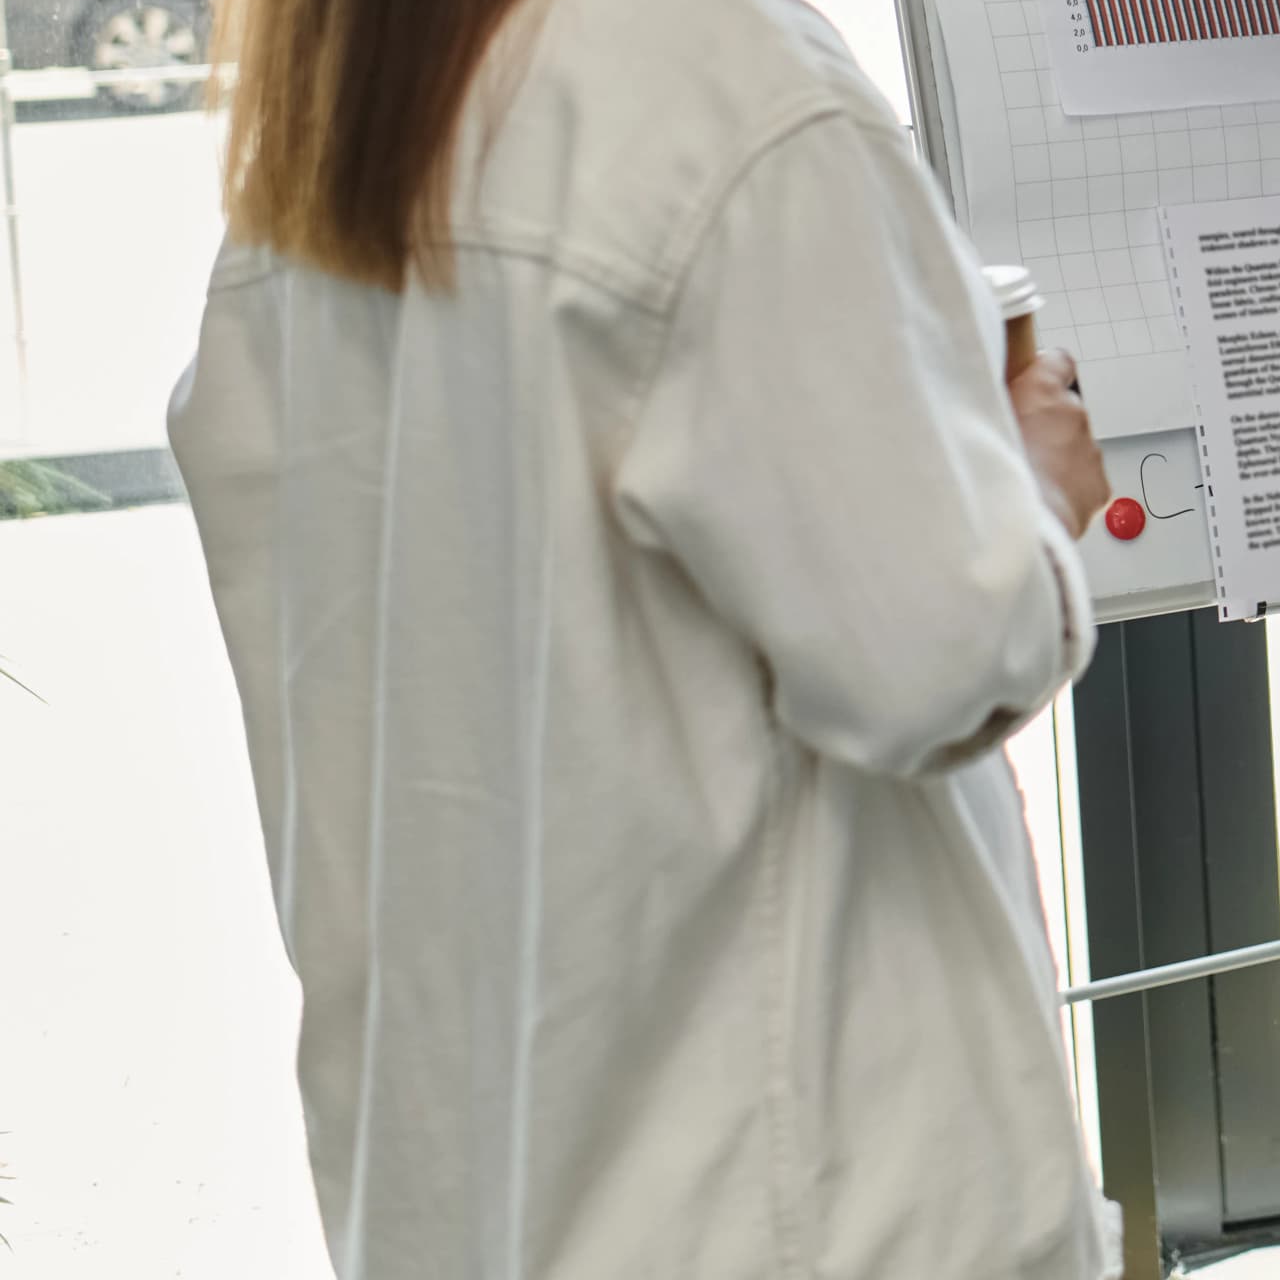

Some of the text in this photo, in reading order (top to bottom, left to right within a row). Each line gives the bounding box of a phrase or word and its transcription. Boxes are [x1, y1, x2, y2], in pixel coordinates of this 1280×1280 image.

[1066, 0, 1078, 7] 6,0
[1070, 13, 1081, 21] 4,0
[1073, 28, 1085, 37] 2,0
[1076, 44, 1088, 52] 0,0
